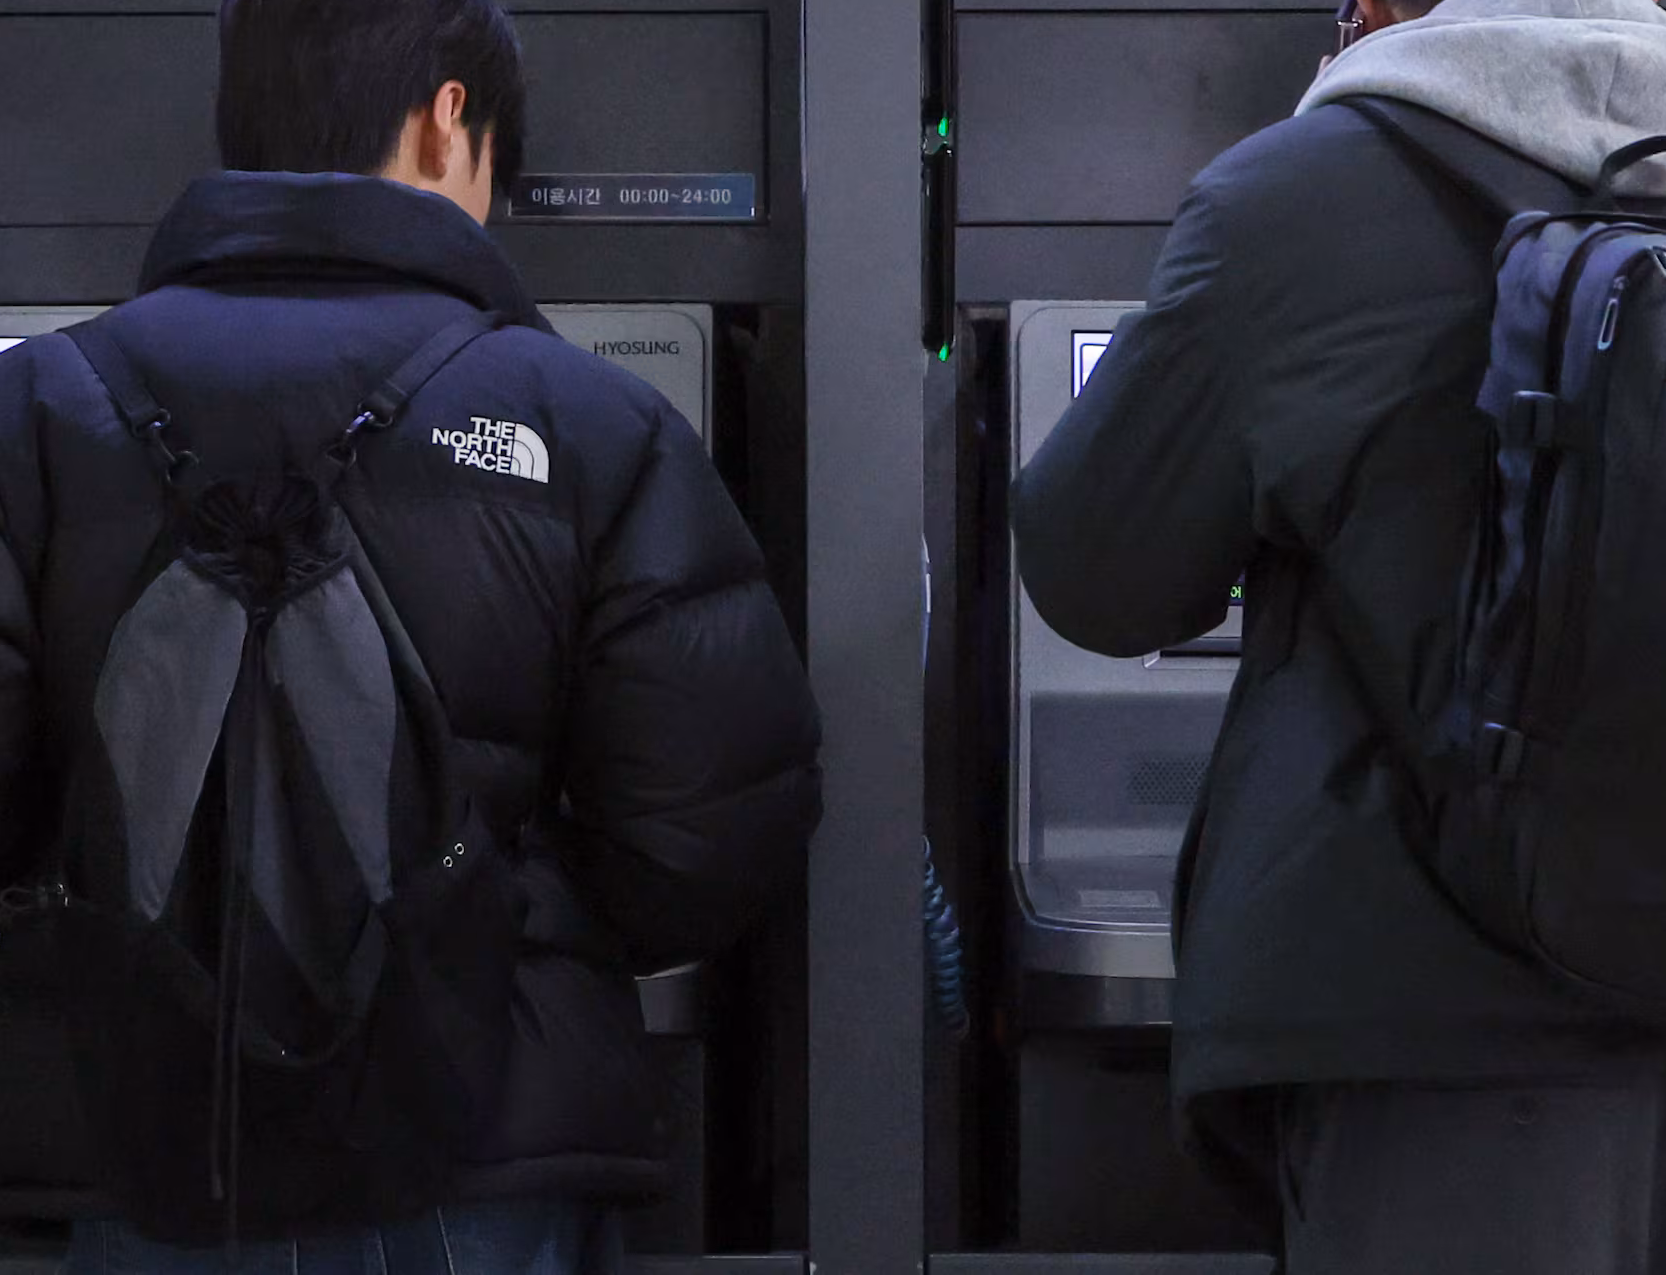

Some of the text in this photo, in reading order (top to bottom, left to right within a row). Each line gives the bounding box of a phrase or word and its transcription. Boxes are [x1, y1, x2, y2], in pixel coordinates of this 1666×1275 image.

[532, 188, 732, 205] 이용시간 00:00~24:00
[593, 340, 680, 356] HYOSUNG
[470, 416, 515, 440] THE
[432, 428, 513, 457] NORTH
[454, 447, 511, 474] FACE
